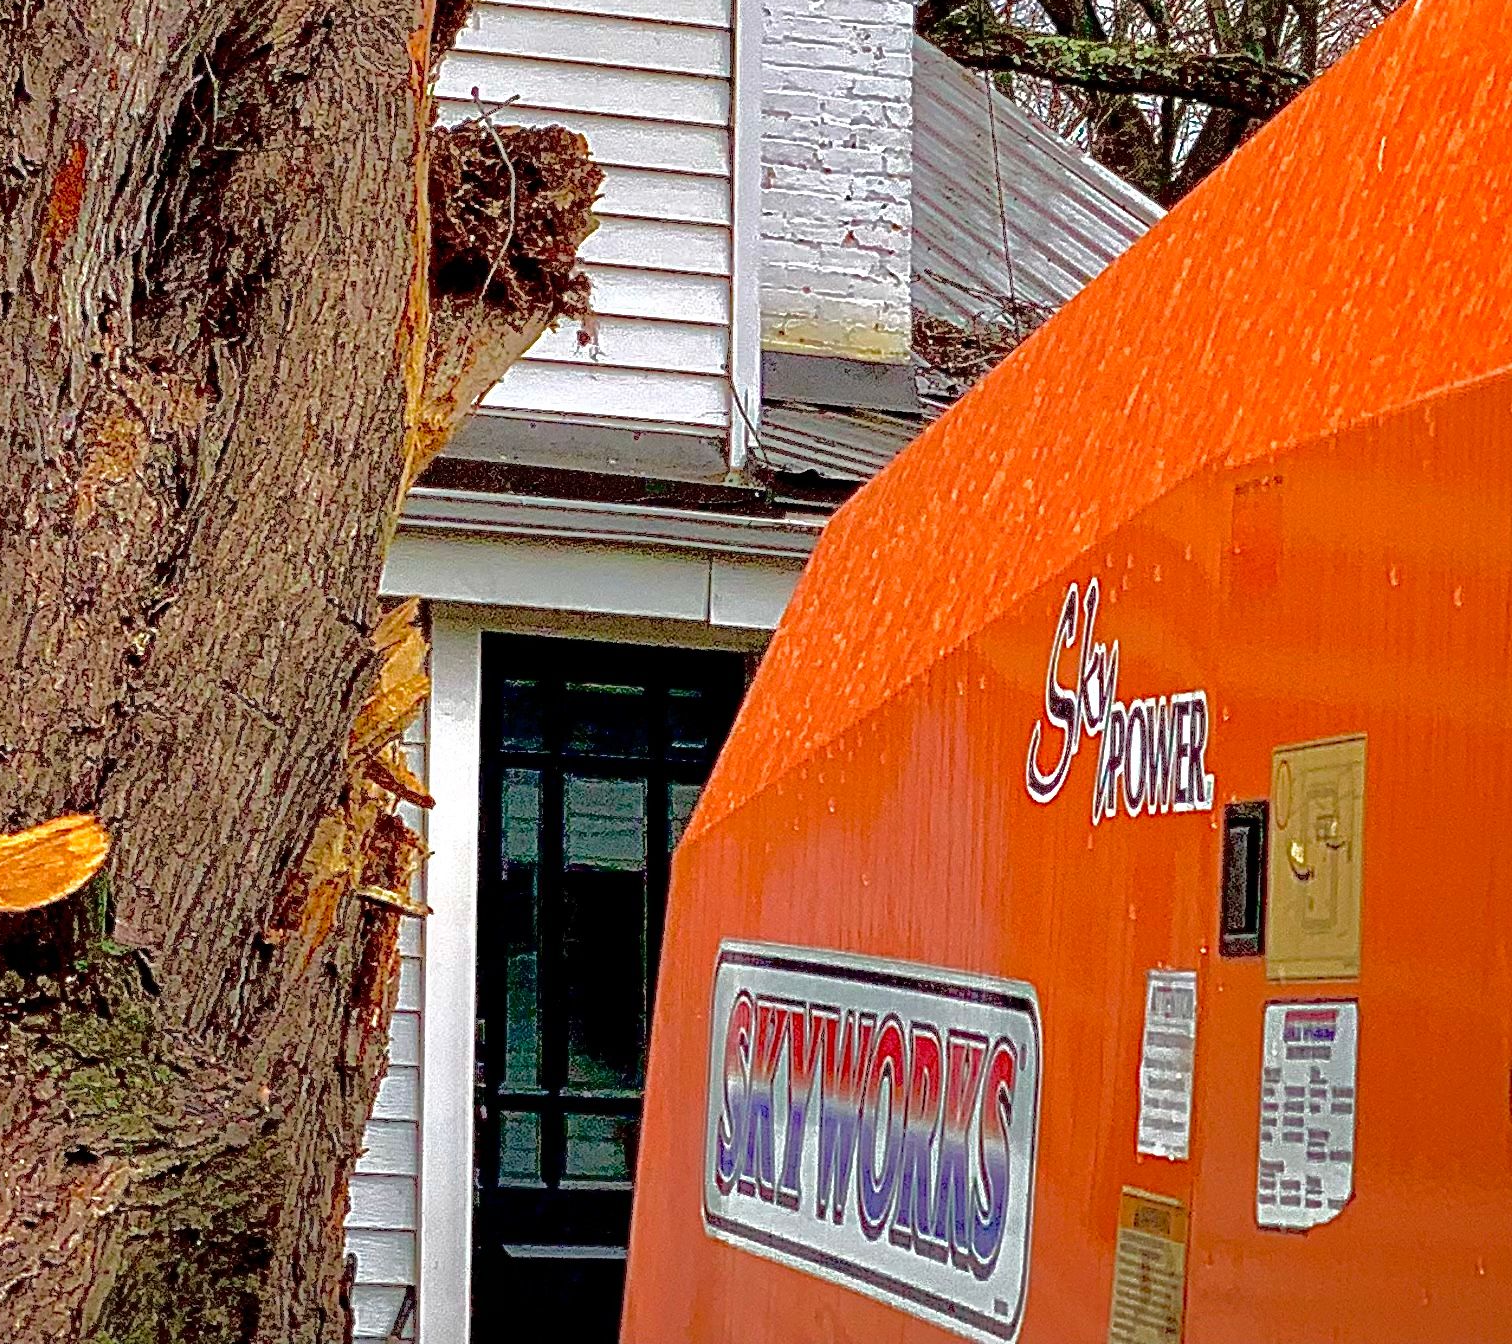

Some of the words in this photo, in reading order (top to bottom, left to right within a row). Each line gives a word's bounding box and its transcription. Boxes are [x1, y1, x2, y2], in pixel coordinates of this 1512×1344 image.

[1026, 578, 1119, 825] Sky
[1104, 692, 1210, 815] POWER
[716, 990, 1017, 1281] SKYWORKS
